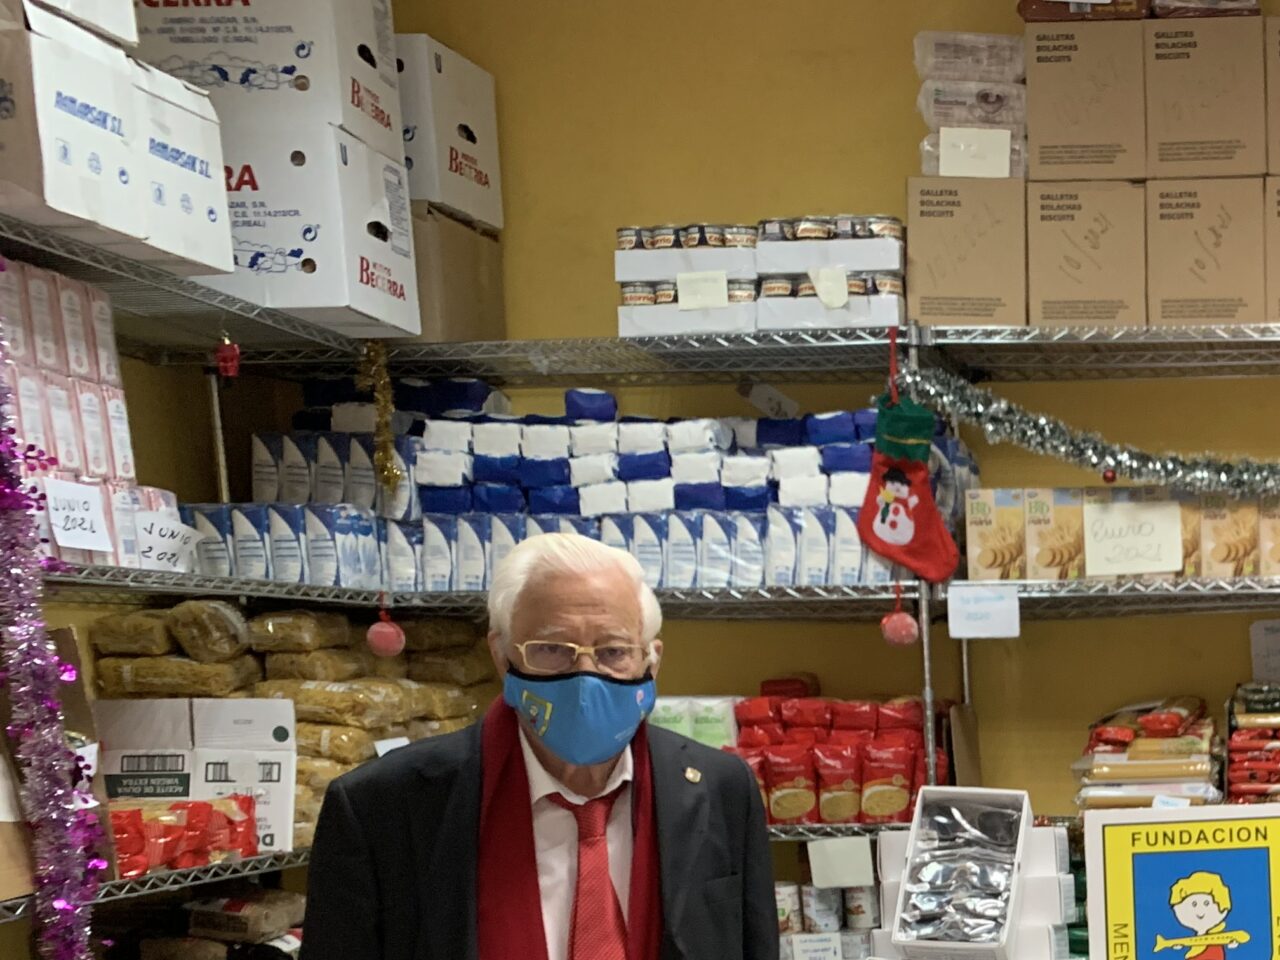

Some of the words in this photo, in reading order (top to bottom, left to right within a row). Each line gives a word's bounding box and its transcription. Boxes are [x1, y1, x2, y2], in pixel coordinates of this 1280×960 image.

[1036, 34, 1075, 42] GALLETAS
[1155, 31, 1194, 39] GALLETAS
[1036, 44, 1078, 53] BOLACHAS
[1155, 41, 1197, 50] BOLACHAS
[1036, 55, 1072, 63] BISCUITS
[1155, 52, 1190, 60] BISCUITS
[919, 189, 958, 197] GALLETAS
[1040, 193, 1078, 201] GALLETAS
[1159, 191, 1198, 200] GALLETAS
[919, 199, 961, 208] BOLACHAS
[1040, 203, 1082, 212] BOLACHAS
[1159, 201, 1201, 210] BOLACHAS
[919, 210, 954, 218] BISCUITS
[1040, 214, 1075, 222] BISCUITS
[1159, 212, 1194, 221] BISCUITS
[1131, 826, 1268, 847] FUNDACION
